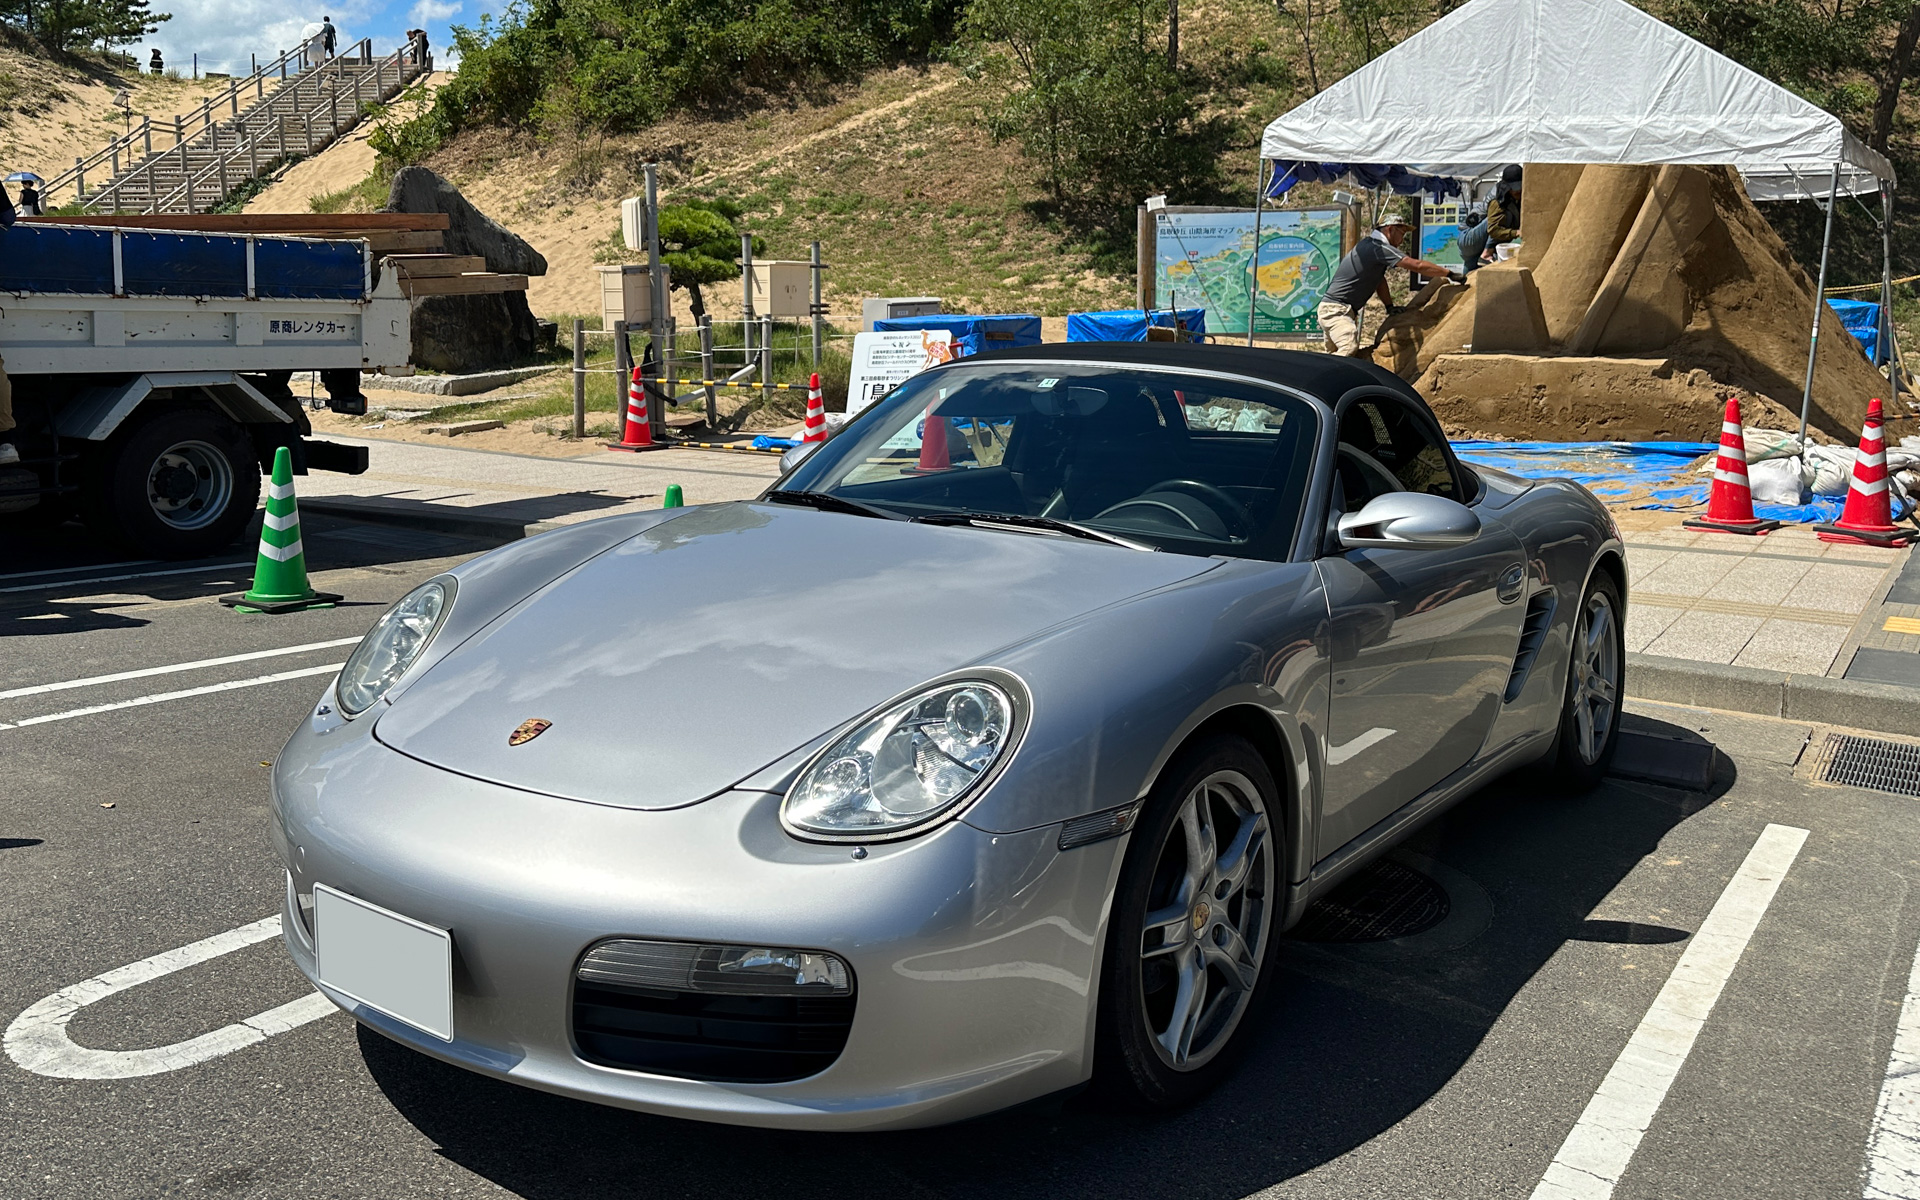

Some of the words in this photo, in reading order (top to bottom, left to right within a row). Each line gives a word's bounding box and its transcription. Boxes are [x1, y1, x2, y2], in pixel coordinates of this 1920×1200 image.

[269, 320, 346, 333] 原商レンタカー
